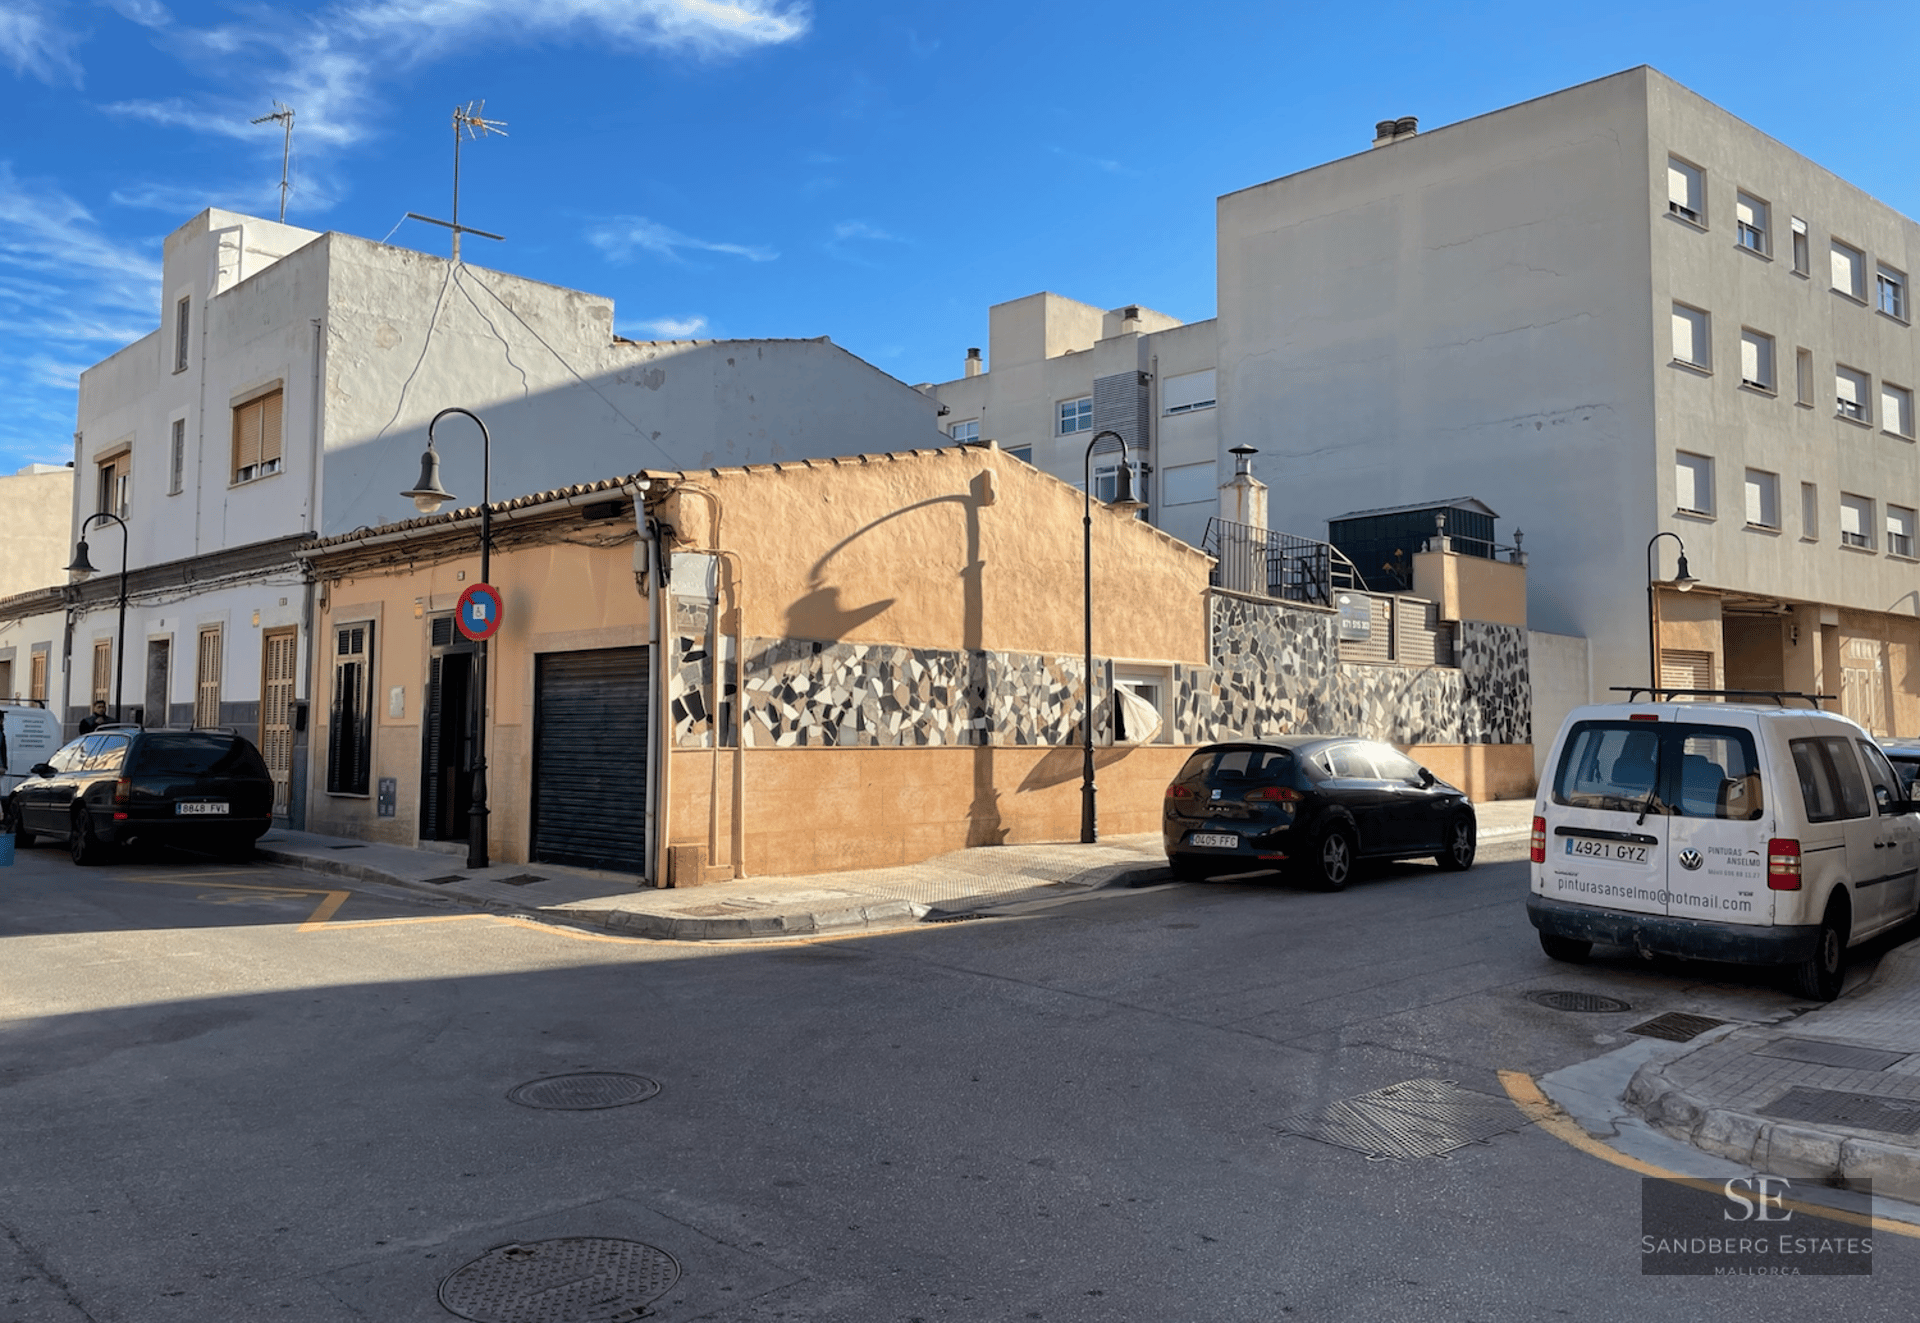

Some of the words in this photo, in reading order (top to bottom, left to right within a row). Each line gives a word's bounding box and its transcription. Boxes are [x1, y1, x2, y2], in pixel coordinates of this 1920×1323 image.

[211, 804, 227, 813] FVL
[1195, 834, 1217, 846] 0405
[1220, 836, 1236, 847] FFC
[1575, 841, 1610, 857] 4921
[1617, 845, 1646, 862] GYZ
[1707, 846, 1743, 857] PINTURAS
[1726, 857, 1761, 867] ANSELMO
[1558, 878, 1752, 912] pinturasanselmo@hotmail.com
